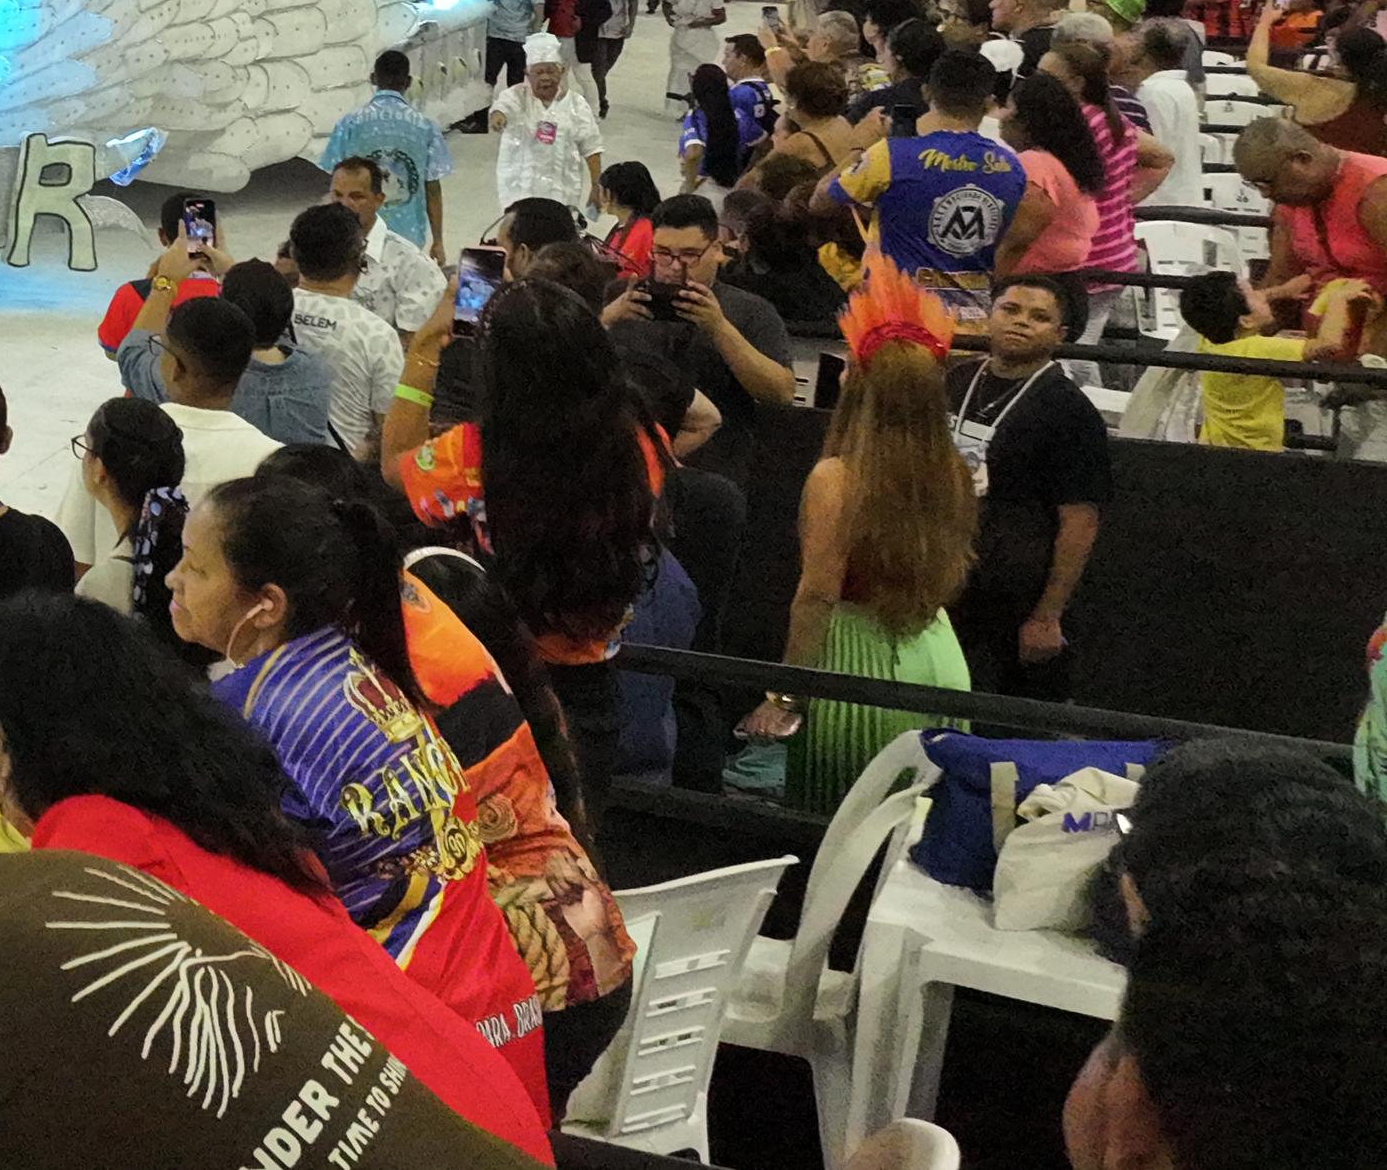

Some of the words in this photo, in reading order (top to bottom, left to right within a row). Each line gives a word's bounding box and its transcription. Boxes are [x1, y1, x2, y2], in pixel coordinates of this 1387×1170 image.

[321, 1021, 373, 1085] THE
[327, 1108, 380, 1170] TIME
[365, 1086, 392, 1116] TO
